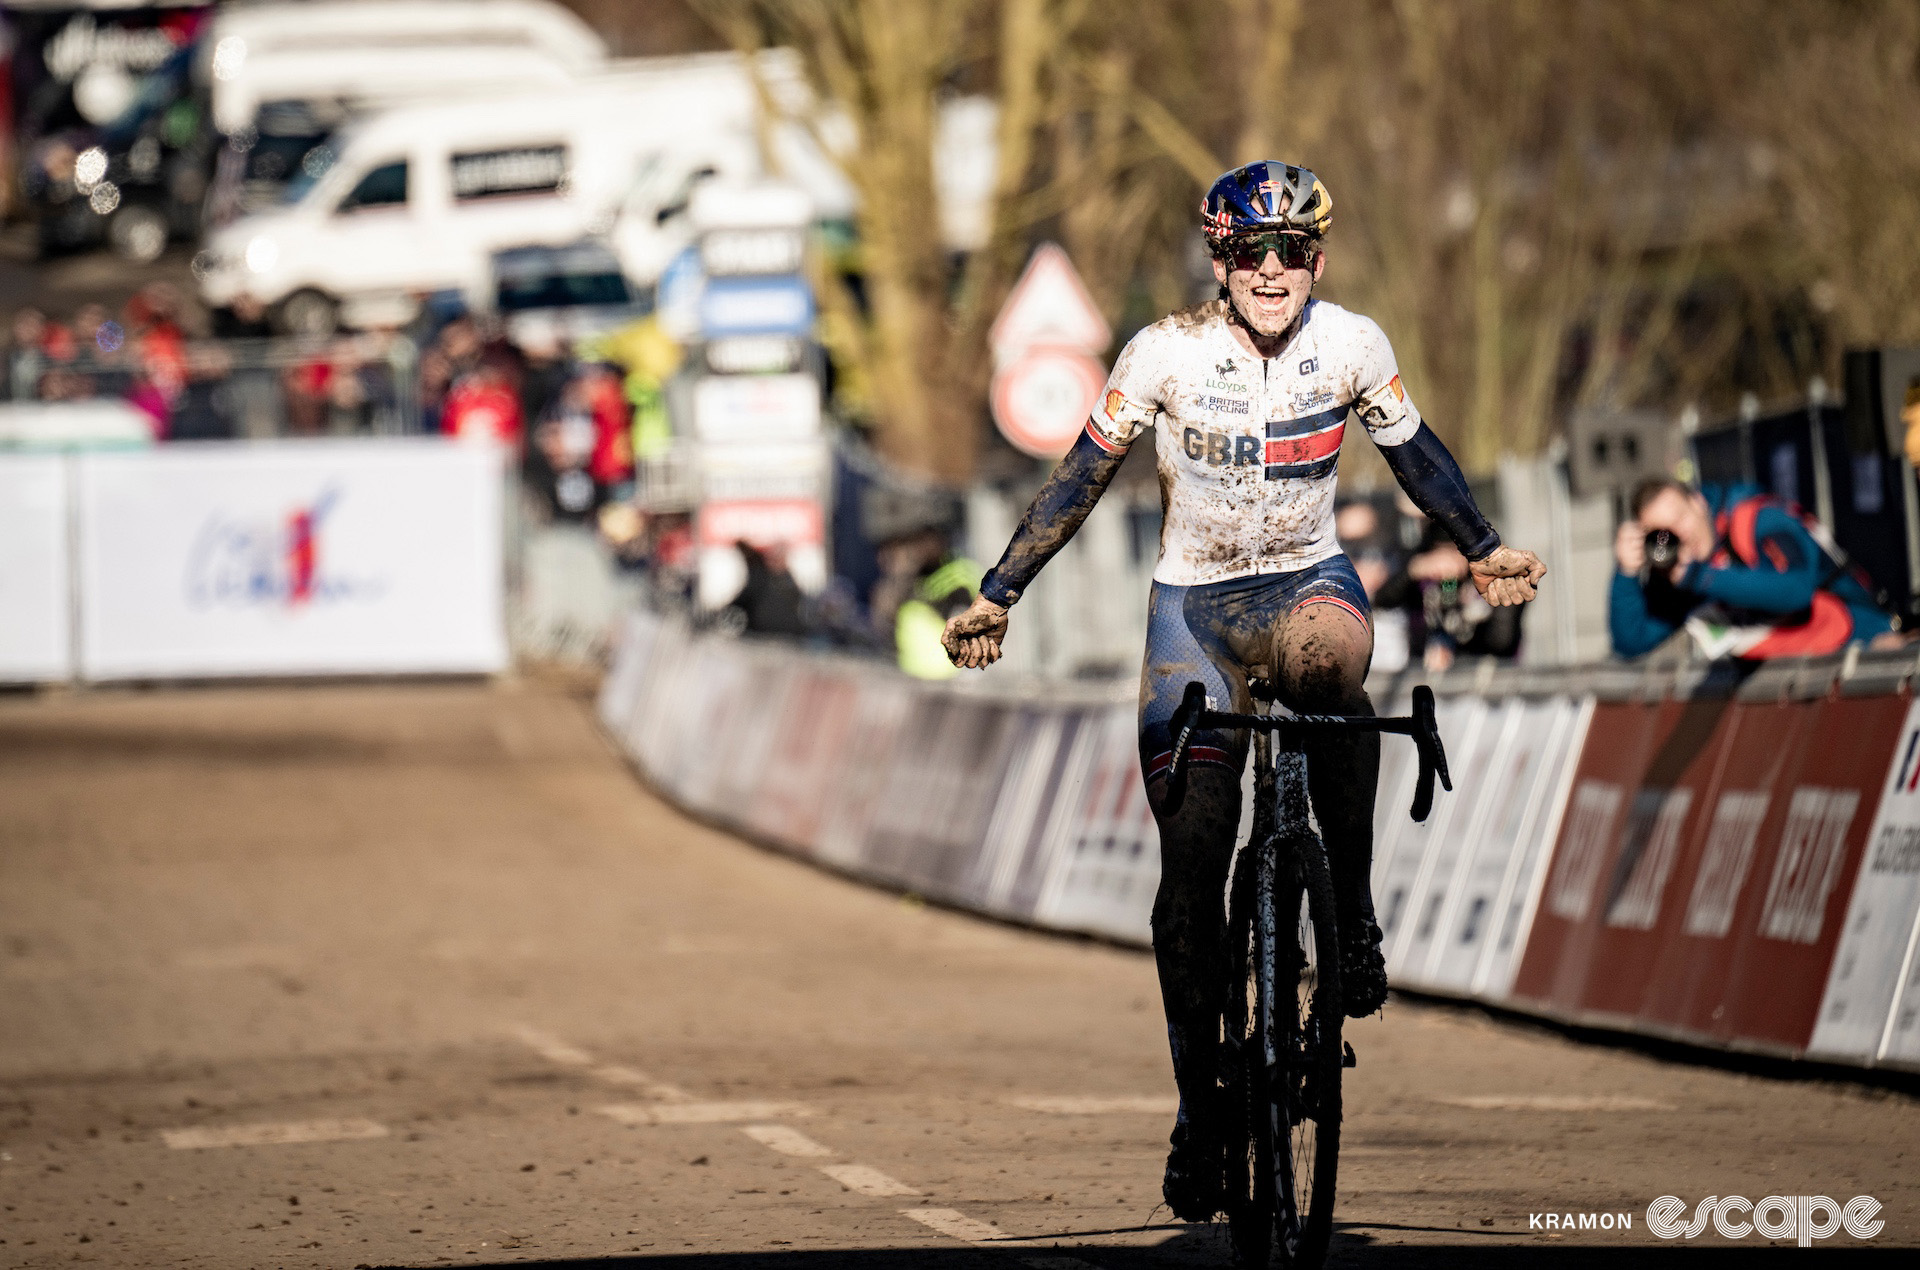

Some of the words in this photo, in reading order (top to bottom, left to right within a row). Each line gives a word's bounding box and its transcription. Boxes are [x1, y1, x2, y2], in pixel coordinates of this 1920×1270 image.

[1205, 379, 1247, 393] LLOYDS
[1209, 396, 1249, 408] BRITISH
[1307, 391, 1334, 402] NATIONAL
[1208, 404, 1249, 414] CYCLING
[1308, 398, 1333, 409] LOTTERY
[1183, 427, 1262, 467] GBR
[1170, 726, 1190, 773] SRAM
